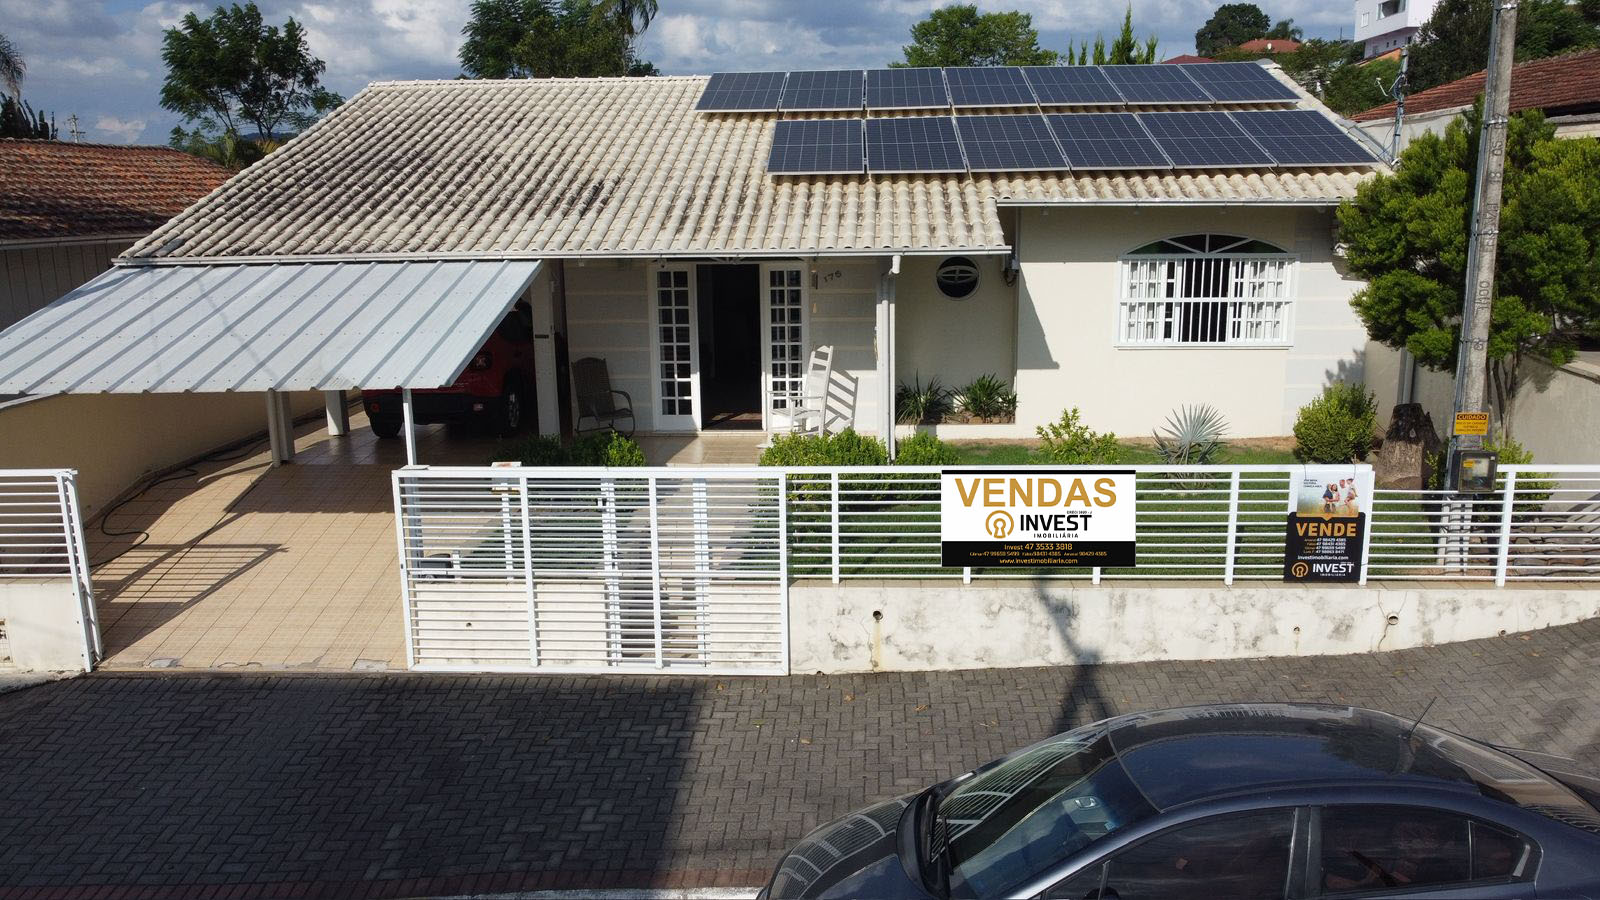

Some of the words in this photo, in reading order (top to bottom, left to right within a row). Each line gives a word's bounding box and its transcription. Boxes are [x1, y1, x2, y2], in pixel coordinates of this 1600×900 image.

[954, 477, 1117, 508] VENDAS
[1020, 514, 1092, 531] INVEST
[1295, 522, 1357, 537] VENDE
[1004, 543, 1024, 551] Invest
[1024, 543, 1034, 551] 47
[1035, 543, 1054, 551] 3533
[1055, 543, 1073, 551] 3818
[1312, 563, 1354, 573] INVEST
